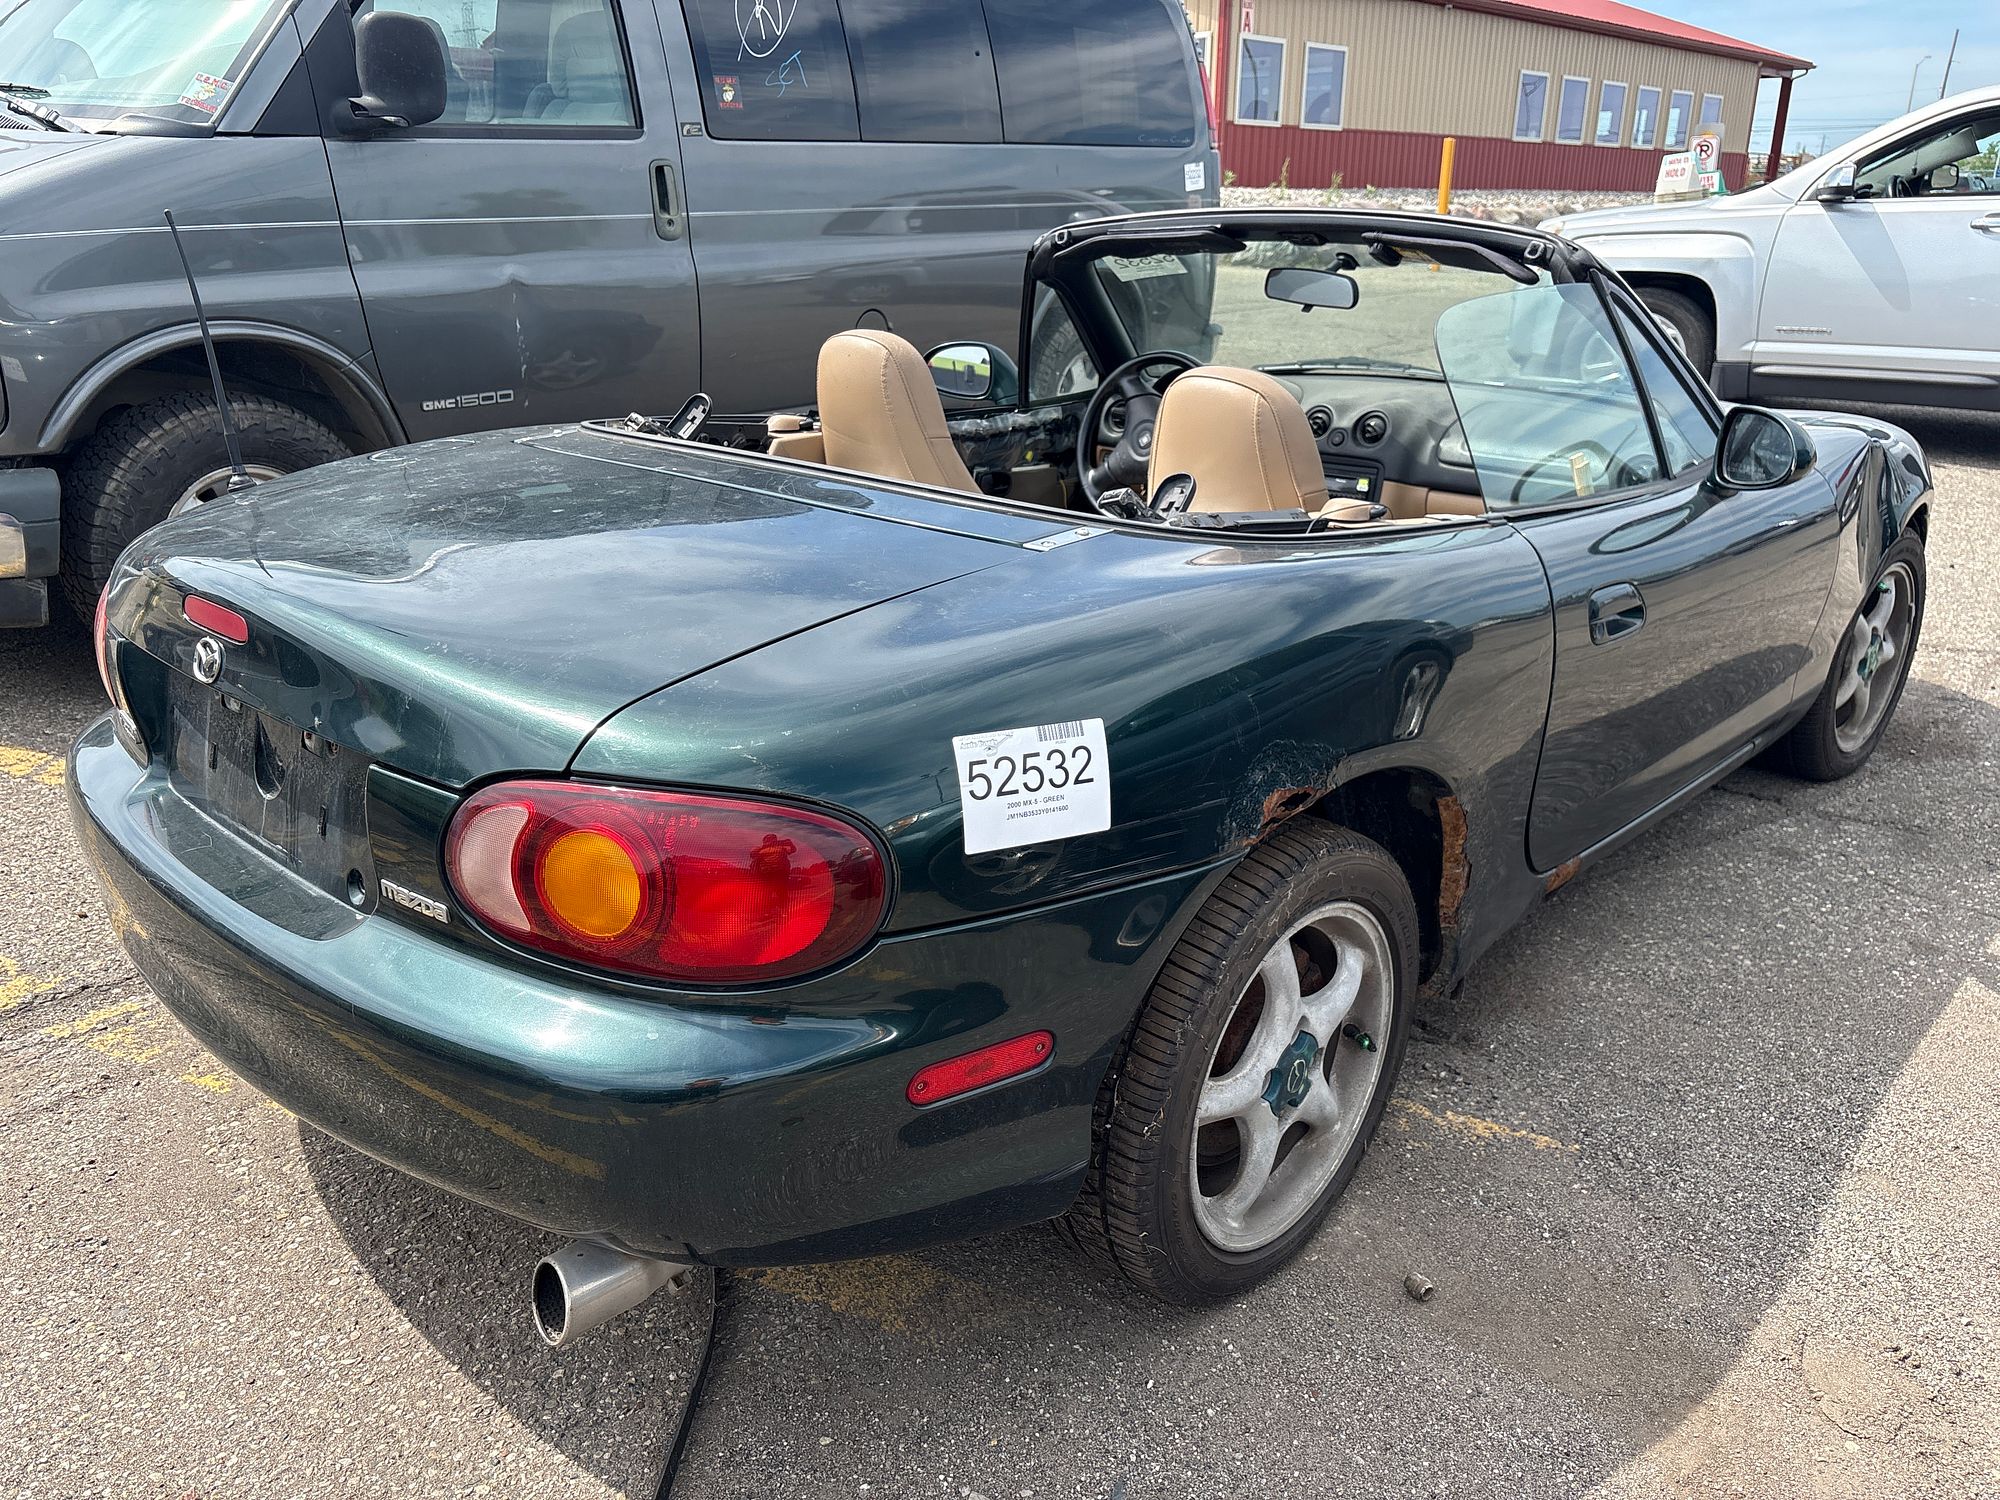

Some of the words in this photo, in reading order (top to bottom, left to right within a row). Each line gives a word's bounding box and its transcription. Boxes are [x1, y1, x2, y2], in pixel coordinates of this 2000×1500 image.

[421, 398, 456, 412] GMC
[456, 389, 515, 409] 1500
[968, 745, 1094, 801] 52532
[1006, 801, 1022, 809] 2000
[1022, 798, 1038, 806] MX-5
[1042, 794, 1065, 803] GREEN
